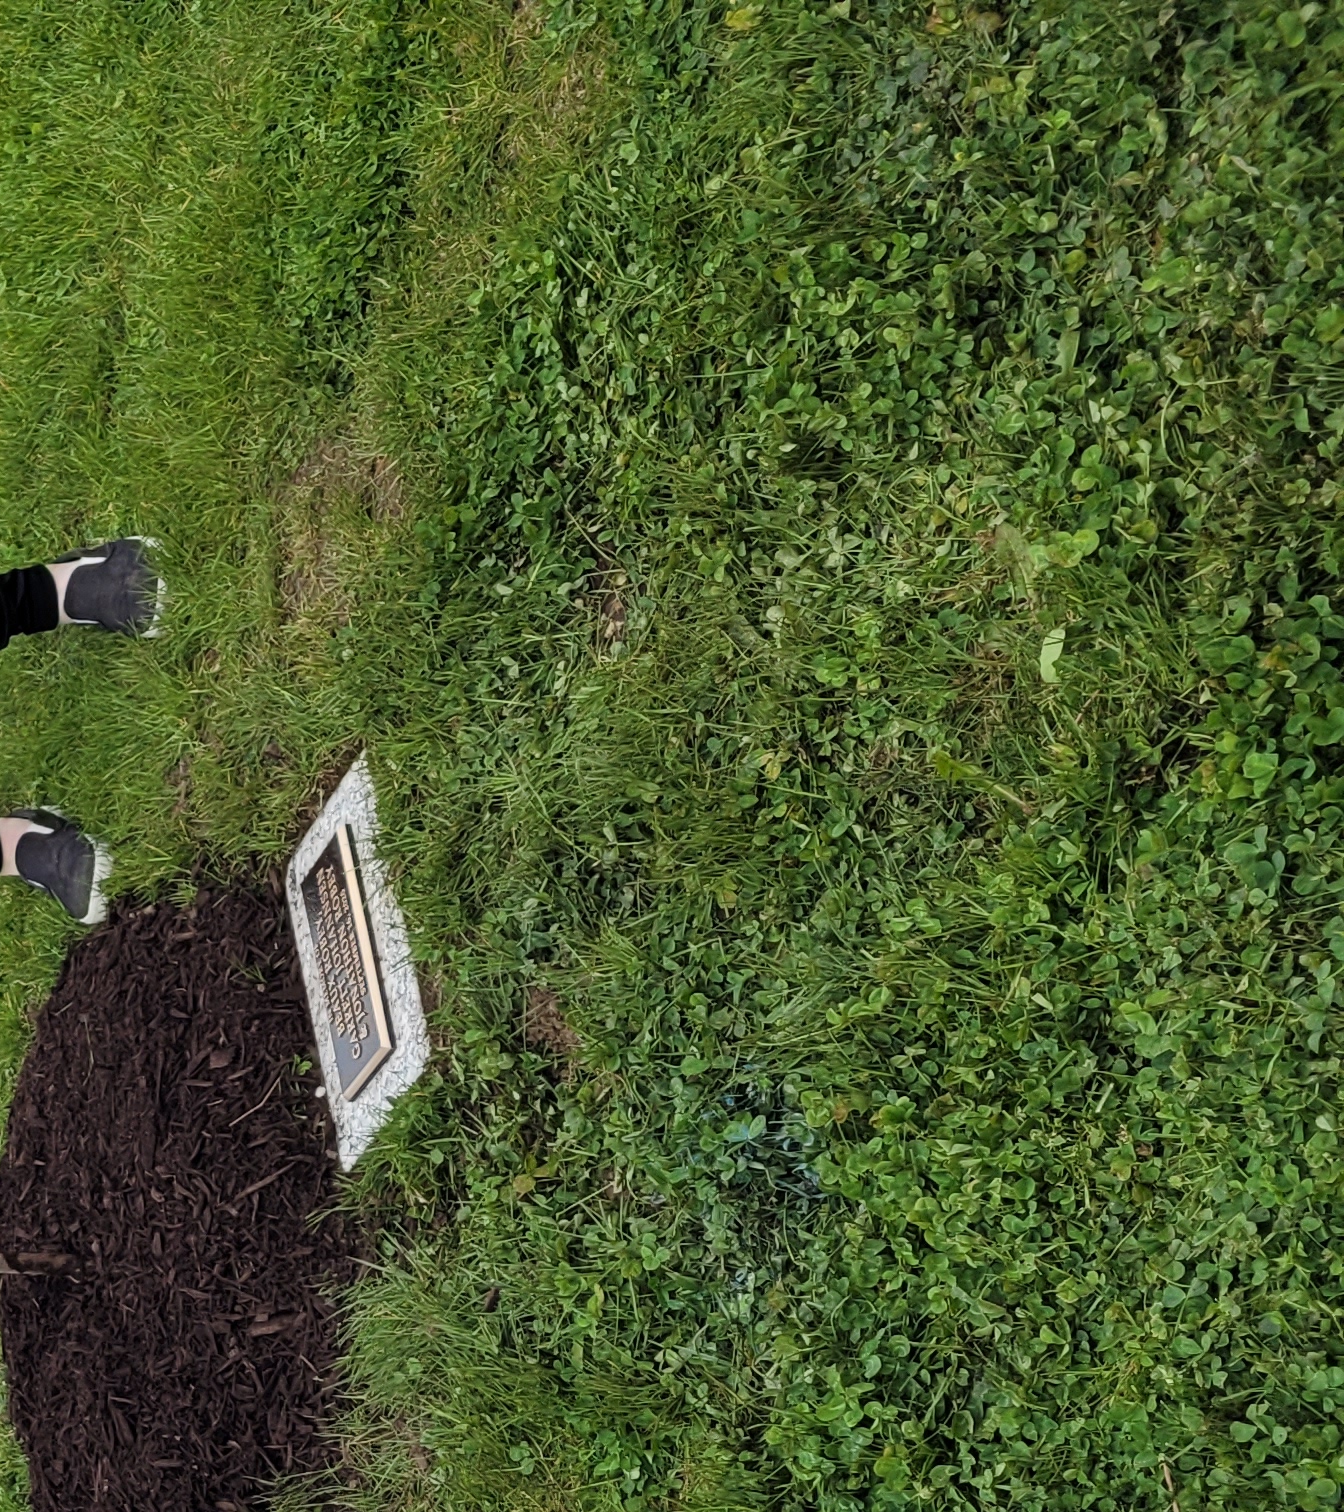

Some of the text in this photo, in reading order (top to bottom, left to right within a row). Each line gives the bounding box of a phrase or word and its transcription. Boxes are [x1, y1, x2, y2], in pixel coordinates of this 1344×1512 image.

[313, 910, 346, 1038] BEAUX ROBEY,
[316, 867, 361, 1060] GARRETT JOHANNSEN
[325, 864, 368, 1040] & JONATHON ROBEY
[349, 929, 367, 996] SEPTEMBER
